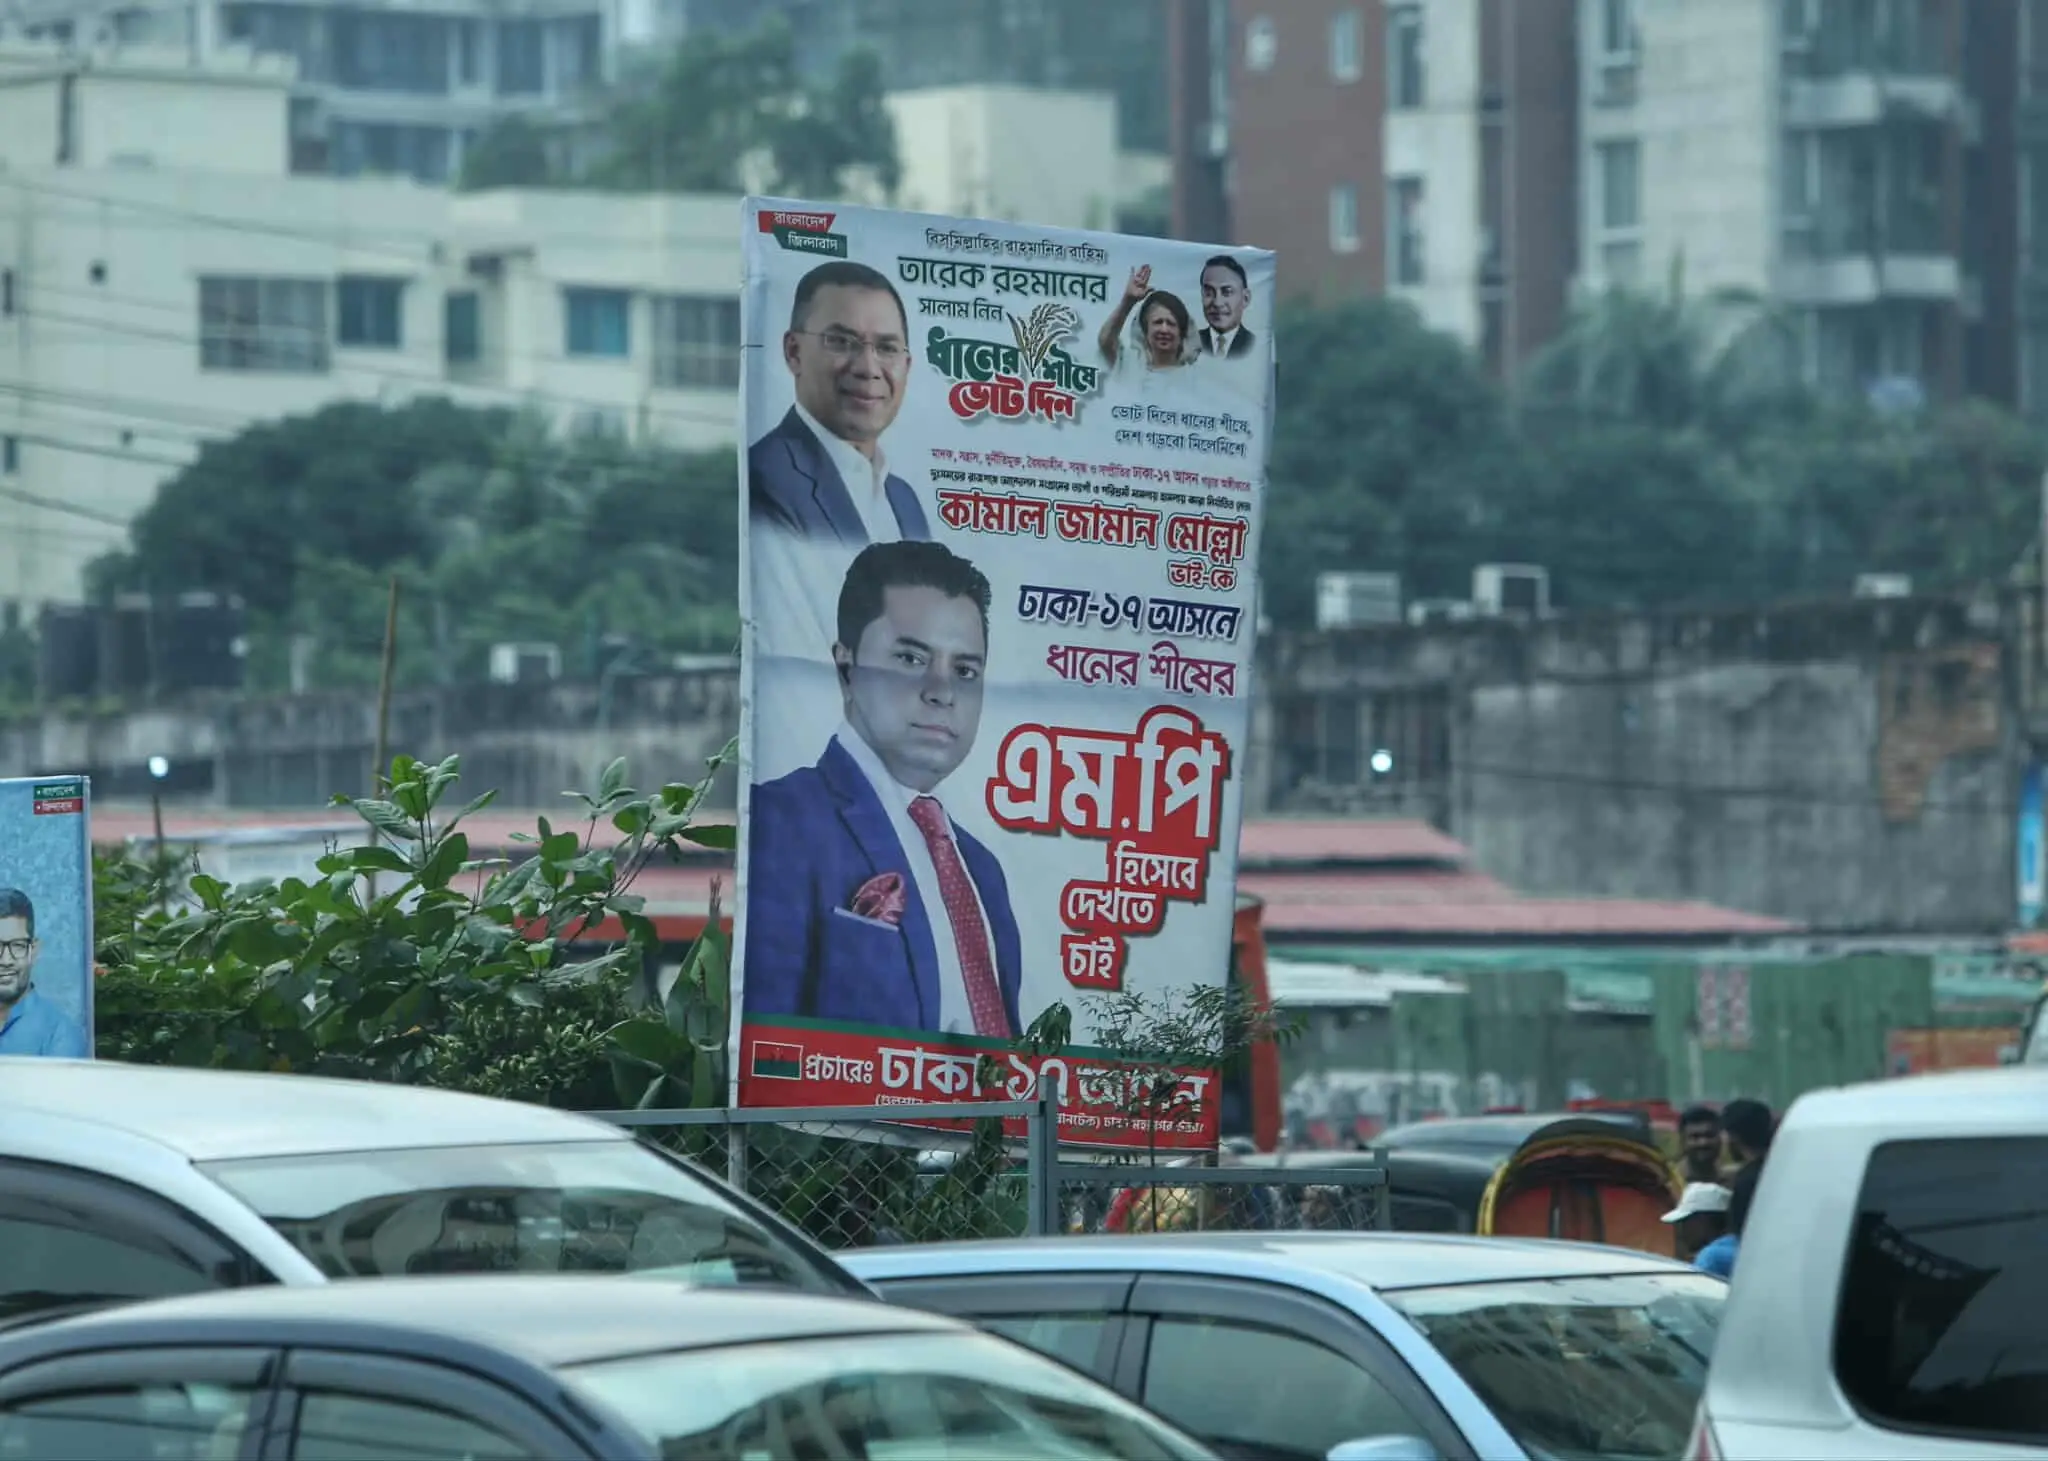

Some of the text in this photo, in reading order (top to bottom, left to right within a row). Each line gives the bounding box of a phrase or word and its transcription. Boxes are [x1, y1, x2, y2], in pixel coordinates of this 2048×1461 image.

[773, 212, 828, 229] বাংলাদেশ
[897, 256, 1108, 303] তারেক রহমানের
[919, 297, 1005, 321] সালাম নিন
[926, 325, 1099, 391] ধানের শীষে
[948, 373, 1077, 421] ভোট দিন
[1111, 404, 1144, 421] ভোট
[1147, 405, 1177, 424] দিলে
[1181, 413, 1216, 430] ধানের
[1115, 429, 1246, 456] দেশ গড়বো মিলেমিশে
[1132, 466, 1170, 483] ঢাকা-১৭
[937, 488, 1249, 566] কামাল জামান মোল্লা
[1168, 561, 1238, 590] ভাই-কে
[1018, 584, 1241, 638] ঢাকা-১৭ আসনে
[1046, 640, 1237, 697] ধানের শীষের
[990, 711, 1223, 838] এম.পি
[1113, 839, 1200, 891] হিসেবে
[1066, 886, 1158, 924] দেখতে
[1067, 936, 1117, 979] চাই
[805, 1052, 875, 1084] প্রচারেঃ
[878, 1046, 1069, 1108] ঢাকা১৭
